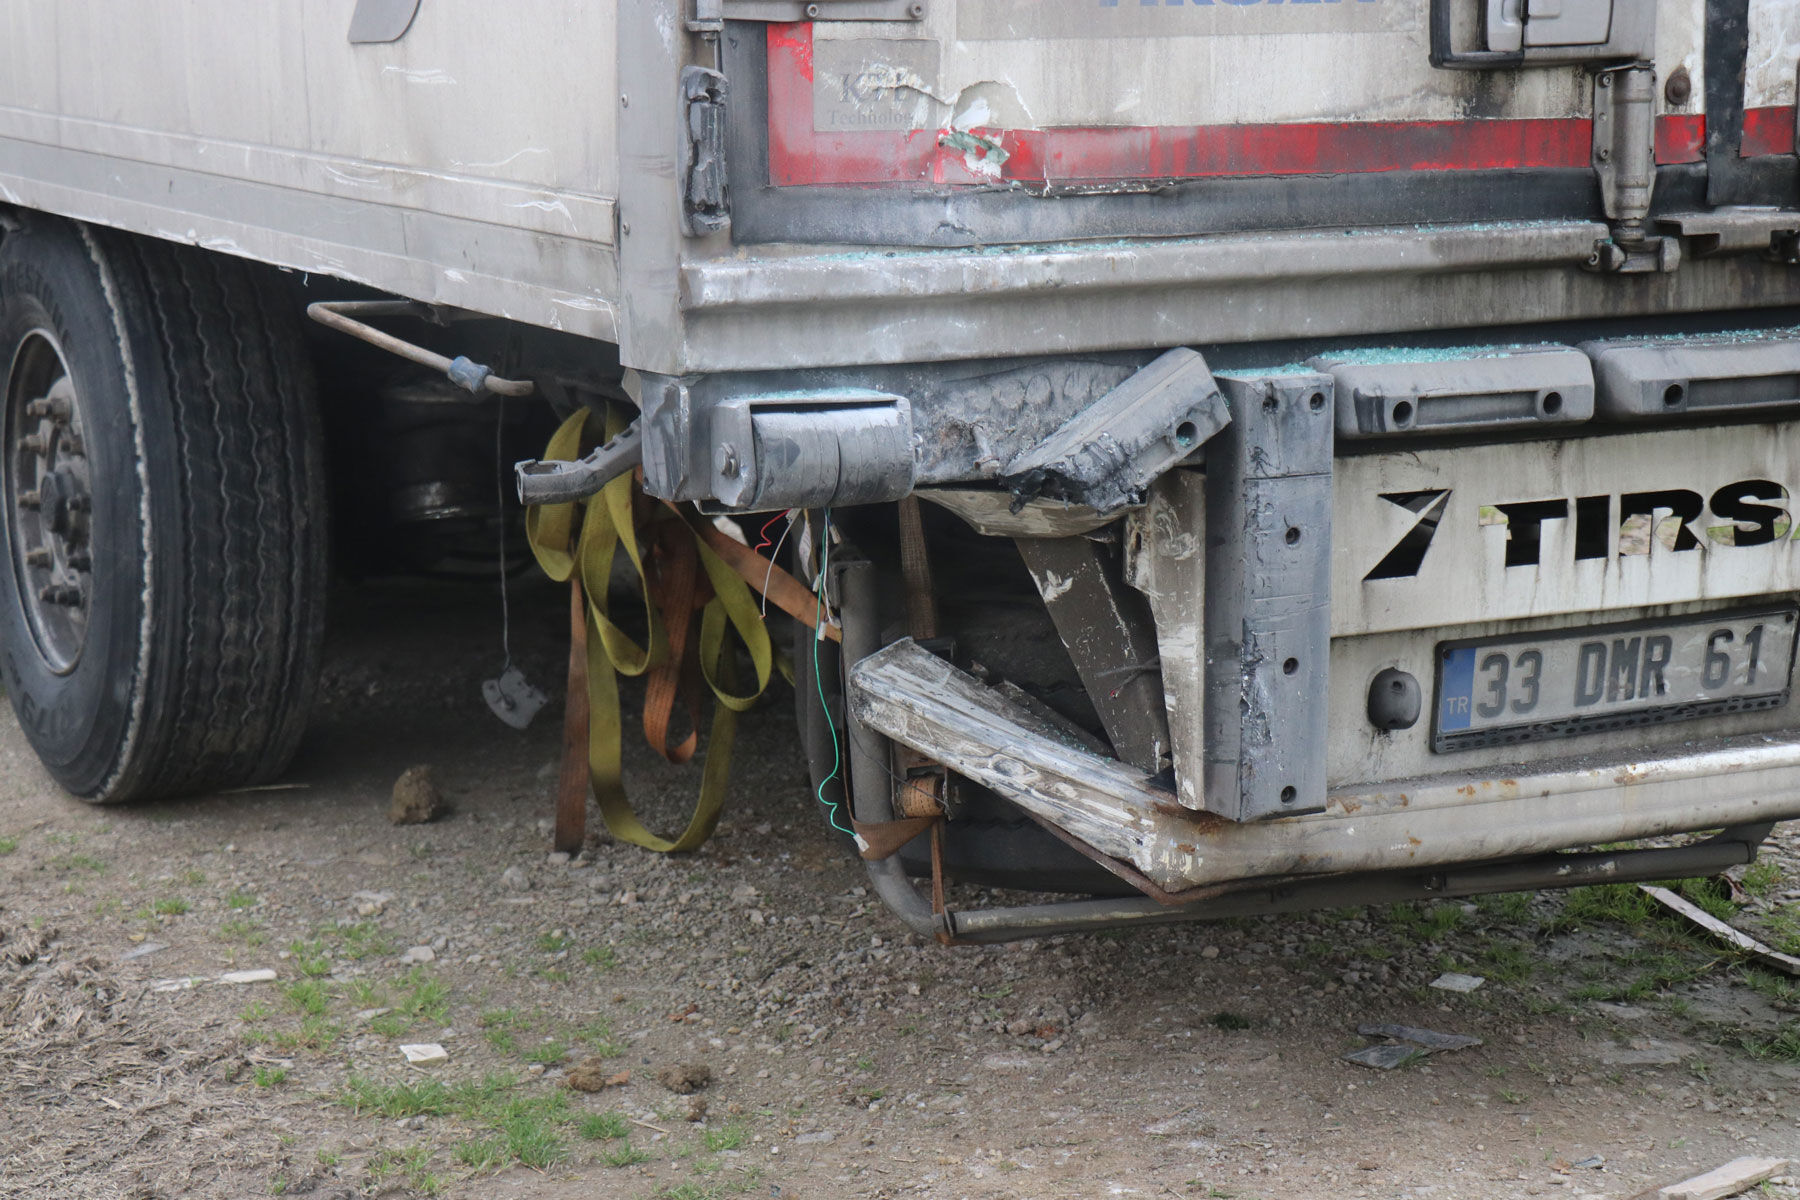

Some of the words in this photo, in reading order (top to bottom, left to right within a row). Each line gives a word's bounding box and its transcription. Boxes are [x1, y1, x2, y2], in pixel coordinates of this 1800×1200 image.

[1479, 479, 1800, 567] TIRS
[1447, 696, 1469, 716] TR
[1476, 650, 1543, 719] 33
[1573, 634, 1672, 707] DMR
[1701, 624, 1764, 690] 61
